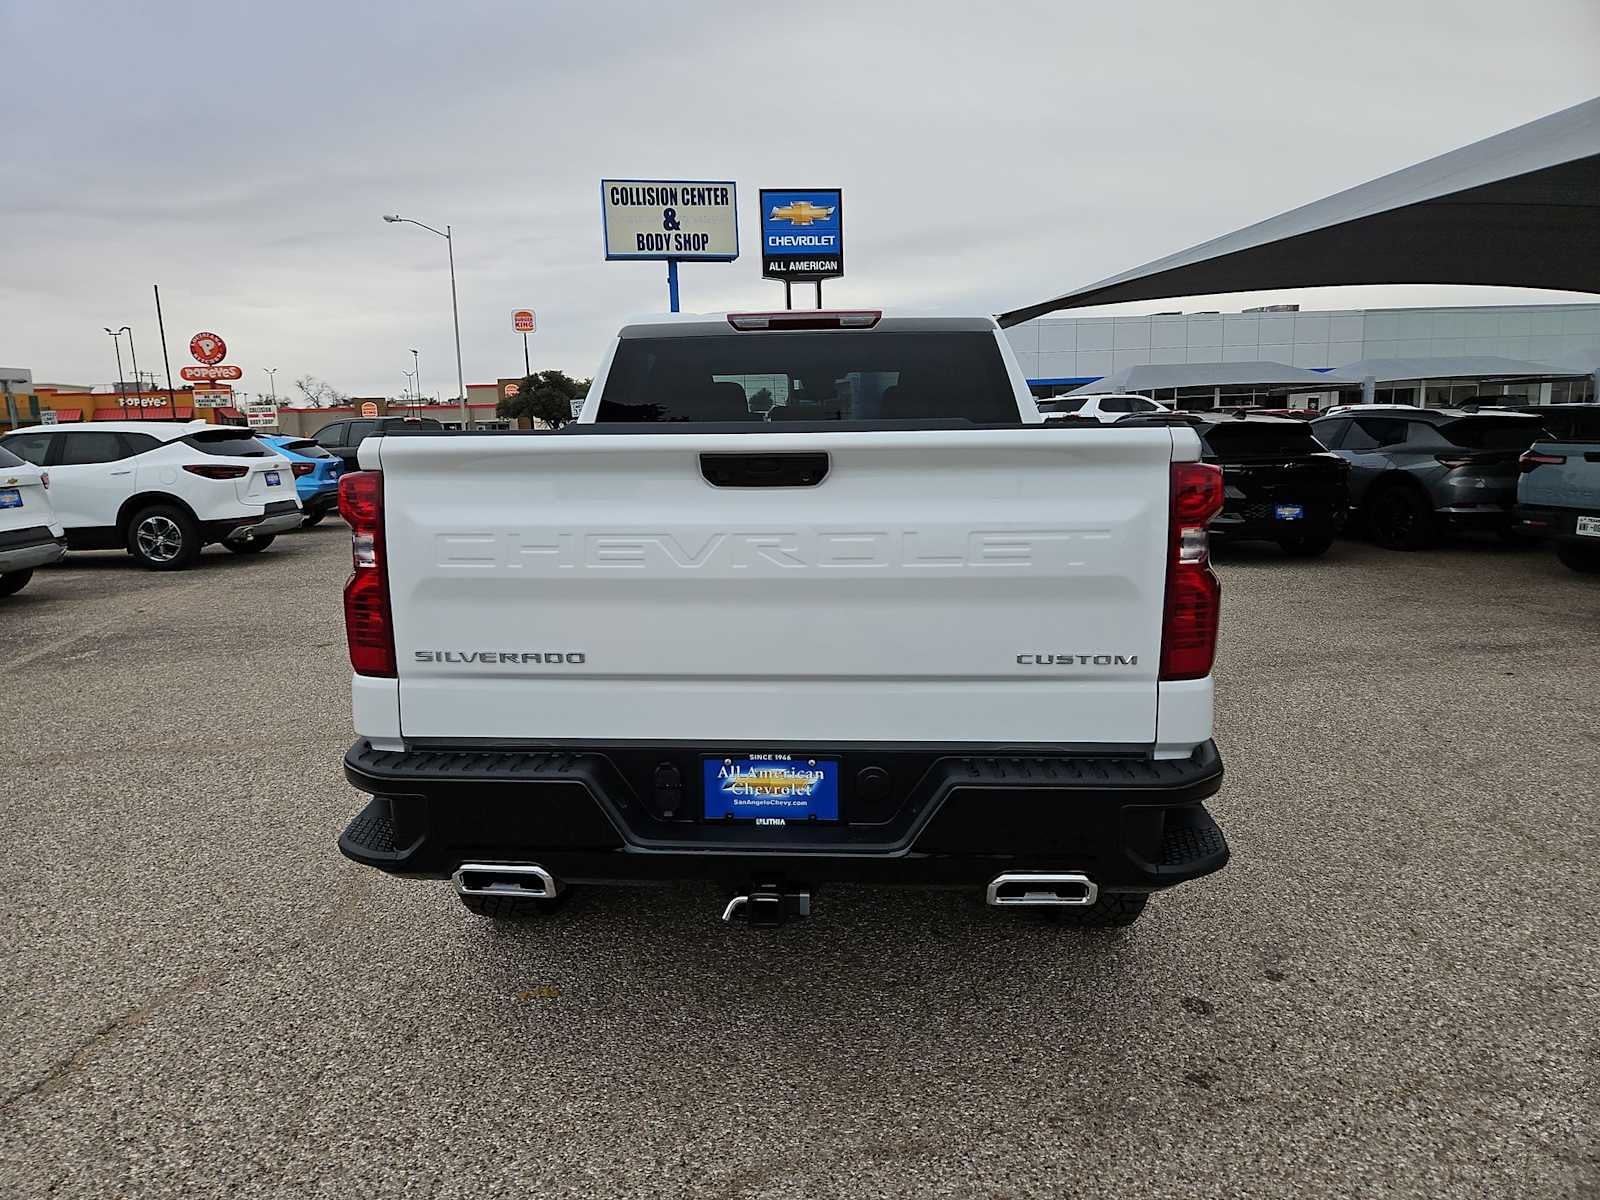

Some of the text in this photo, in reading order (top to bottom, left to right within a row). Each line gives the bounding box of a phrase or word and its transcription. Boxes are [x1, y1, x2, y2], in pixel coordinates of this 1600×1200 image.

[610, 186, 729, 206] COLLISION CENTER
[663, 207, 681, 231] &
[636, 233, 709, 252] BODY SHOP
[768, 235, 836, 247] CHEVROLET
[769, 260, 838, 272] ALL AMERICAN
[185, 367, 236, 379] POPEYES
[118, 397, 167, 408] POPEYES
[434, 529, 1112, 569] CHEVROLET
[414, 650, 586, 665] SILVERADO
[1015, 653, 1138, 666] CUSTOM
[717, 765, 824, 780] All American
[731, 782, 812, 796] Chevrolet
